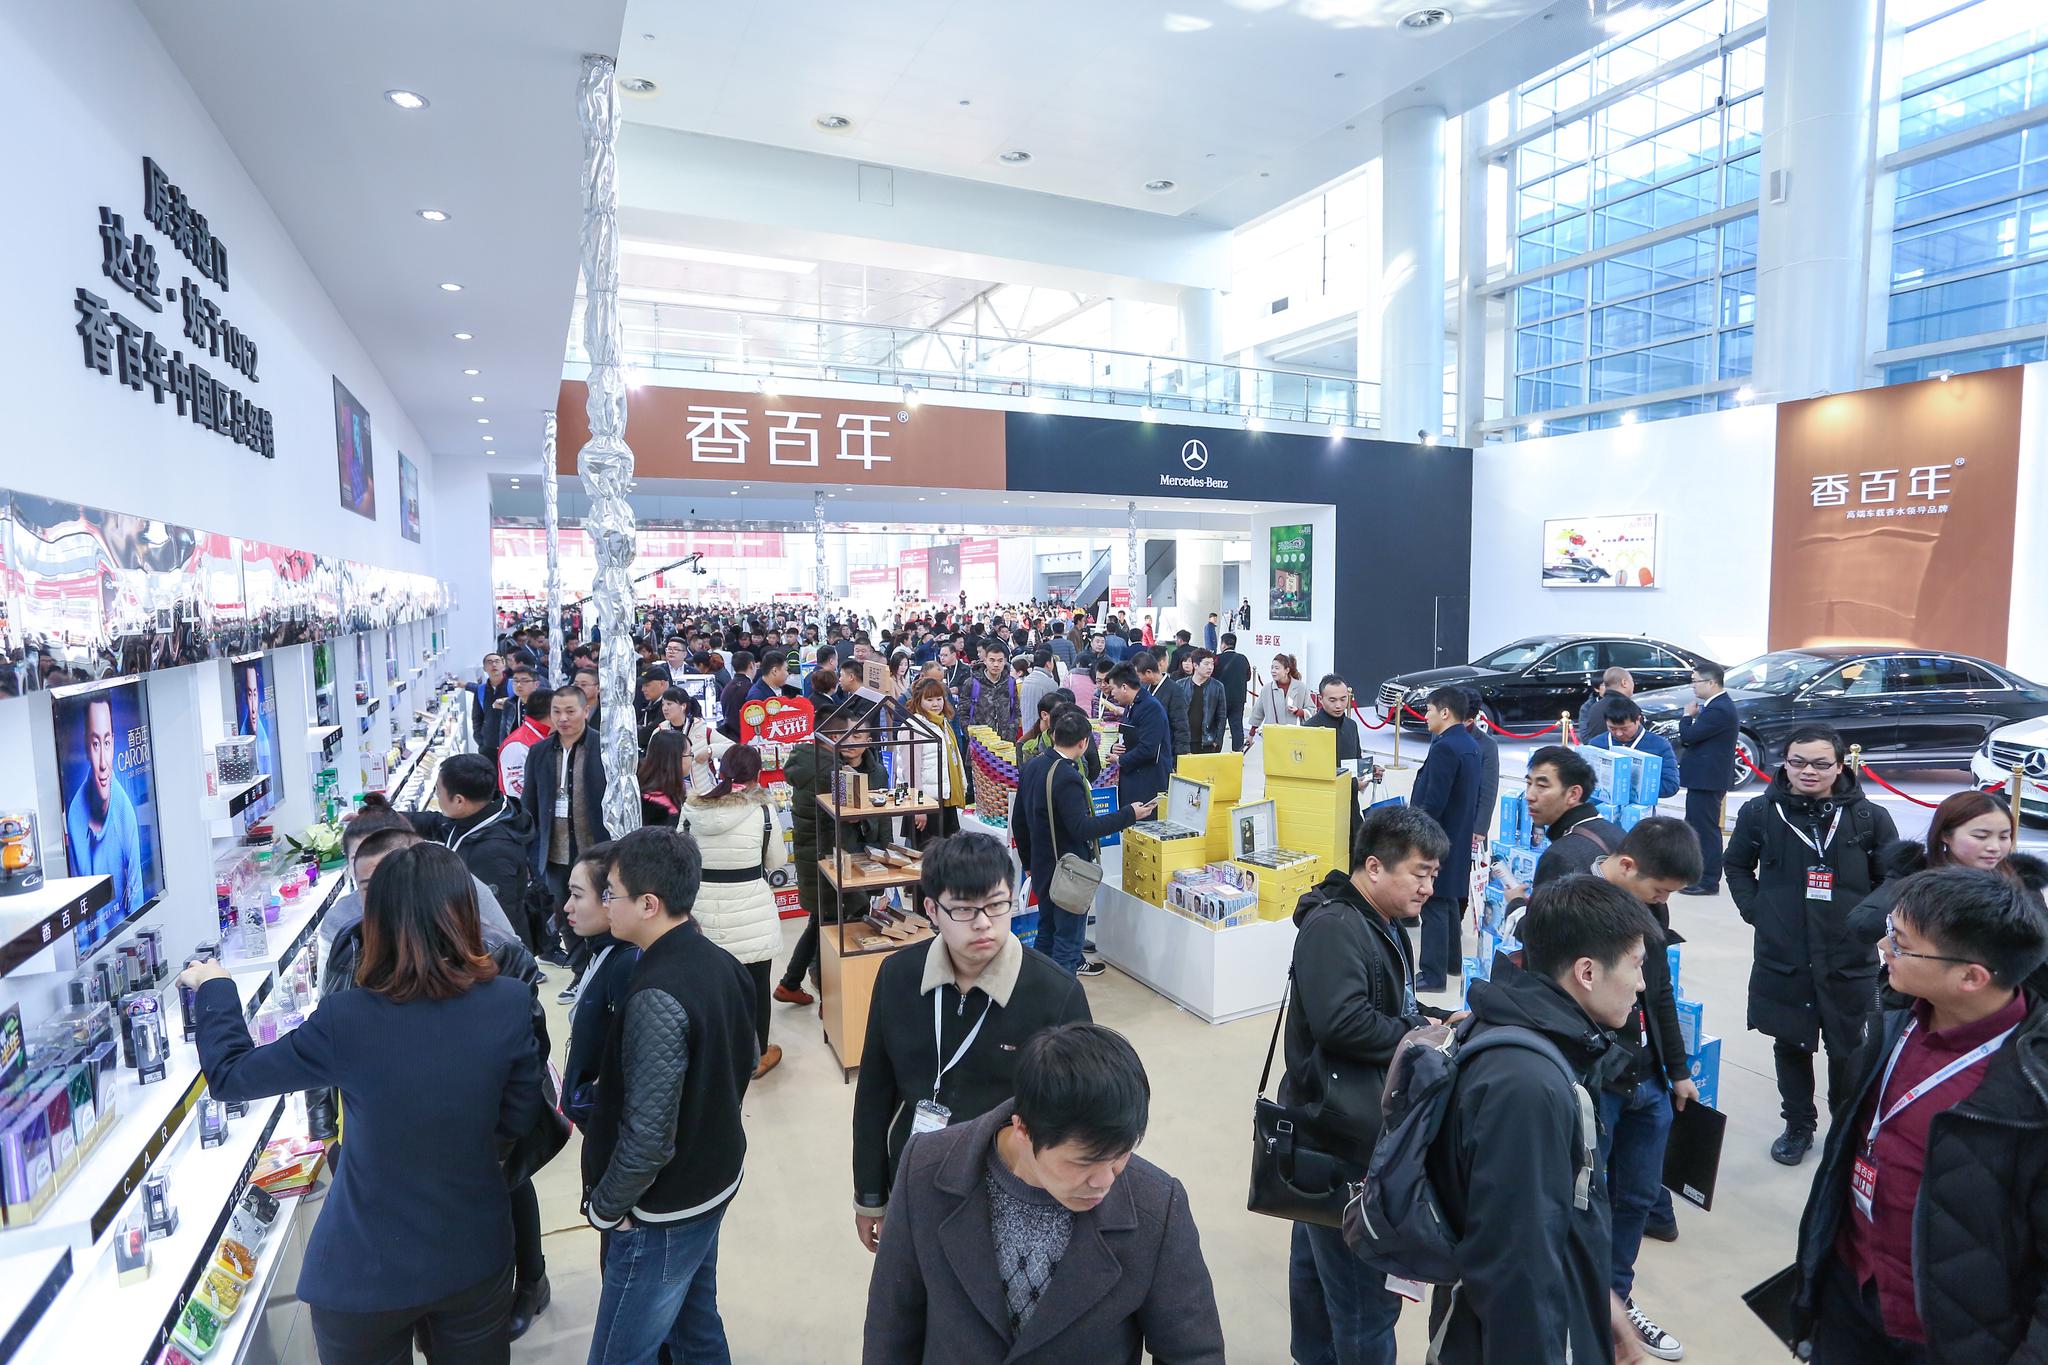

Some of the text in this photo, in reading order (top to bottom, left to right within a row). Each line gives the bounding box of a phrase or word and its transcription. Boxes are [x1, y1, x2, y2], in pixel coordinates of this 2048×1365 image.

[142, 155, 230, 292] 原装进口
[74, 287, 275, 459] 香百年中国区总经销
[685, 405, 893, 470] 香百年
[1159, 474, 1229, 489] Mercedes-Benz
[1810, 464, 1953, 507] 香百年
[1846, 504, 1949, 519] 高端车载香水领导品牌
[1255, 634, 1281, 647] 抽奖区
[127, 725, 149, 748] 香百年
[767, 720, 808, 739] 大牙仔
[41, 898, 90, 943] 香百年
